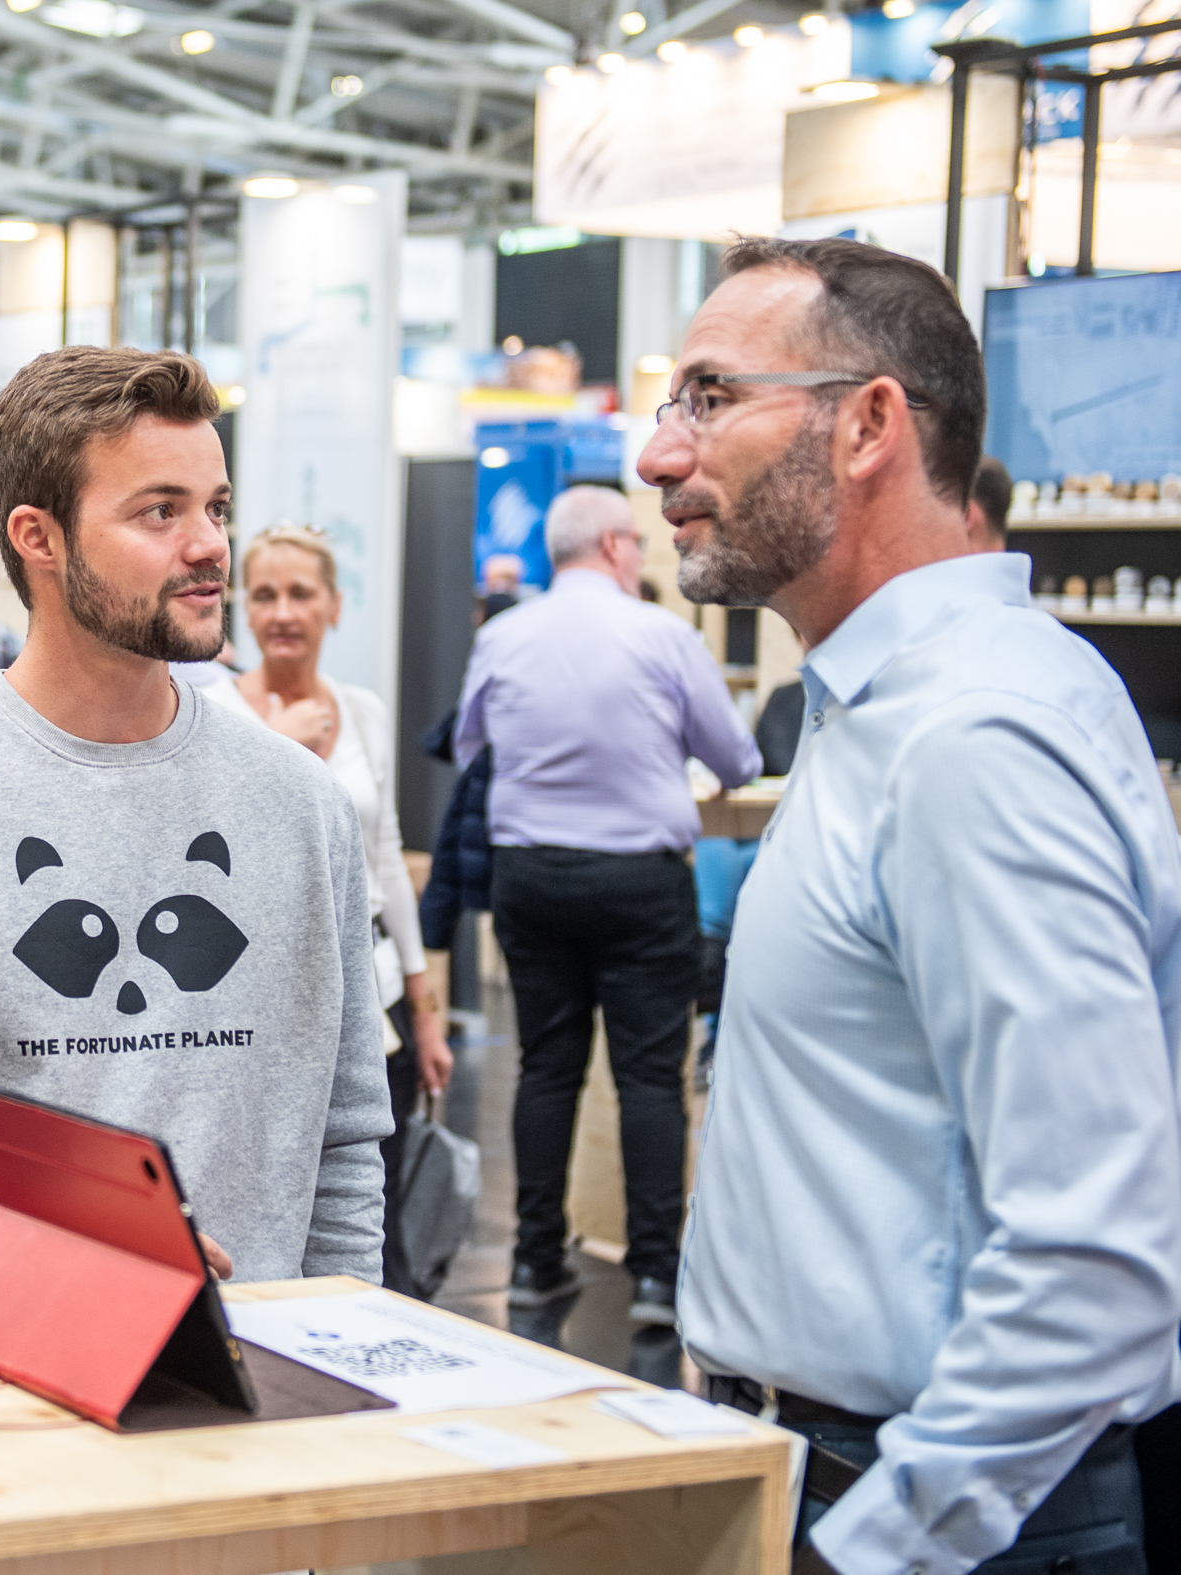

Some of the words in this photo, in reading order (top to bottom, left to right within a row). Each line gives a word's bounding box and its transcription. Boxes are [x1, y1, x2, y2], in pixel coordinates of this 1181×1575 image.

[17, 1039, 60, 1056] THE
[66, 1033, 175, 1055] FORTUNATE
[182, 1030, 254, 1048] PLANET
